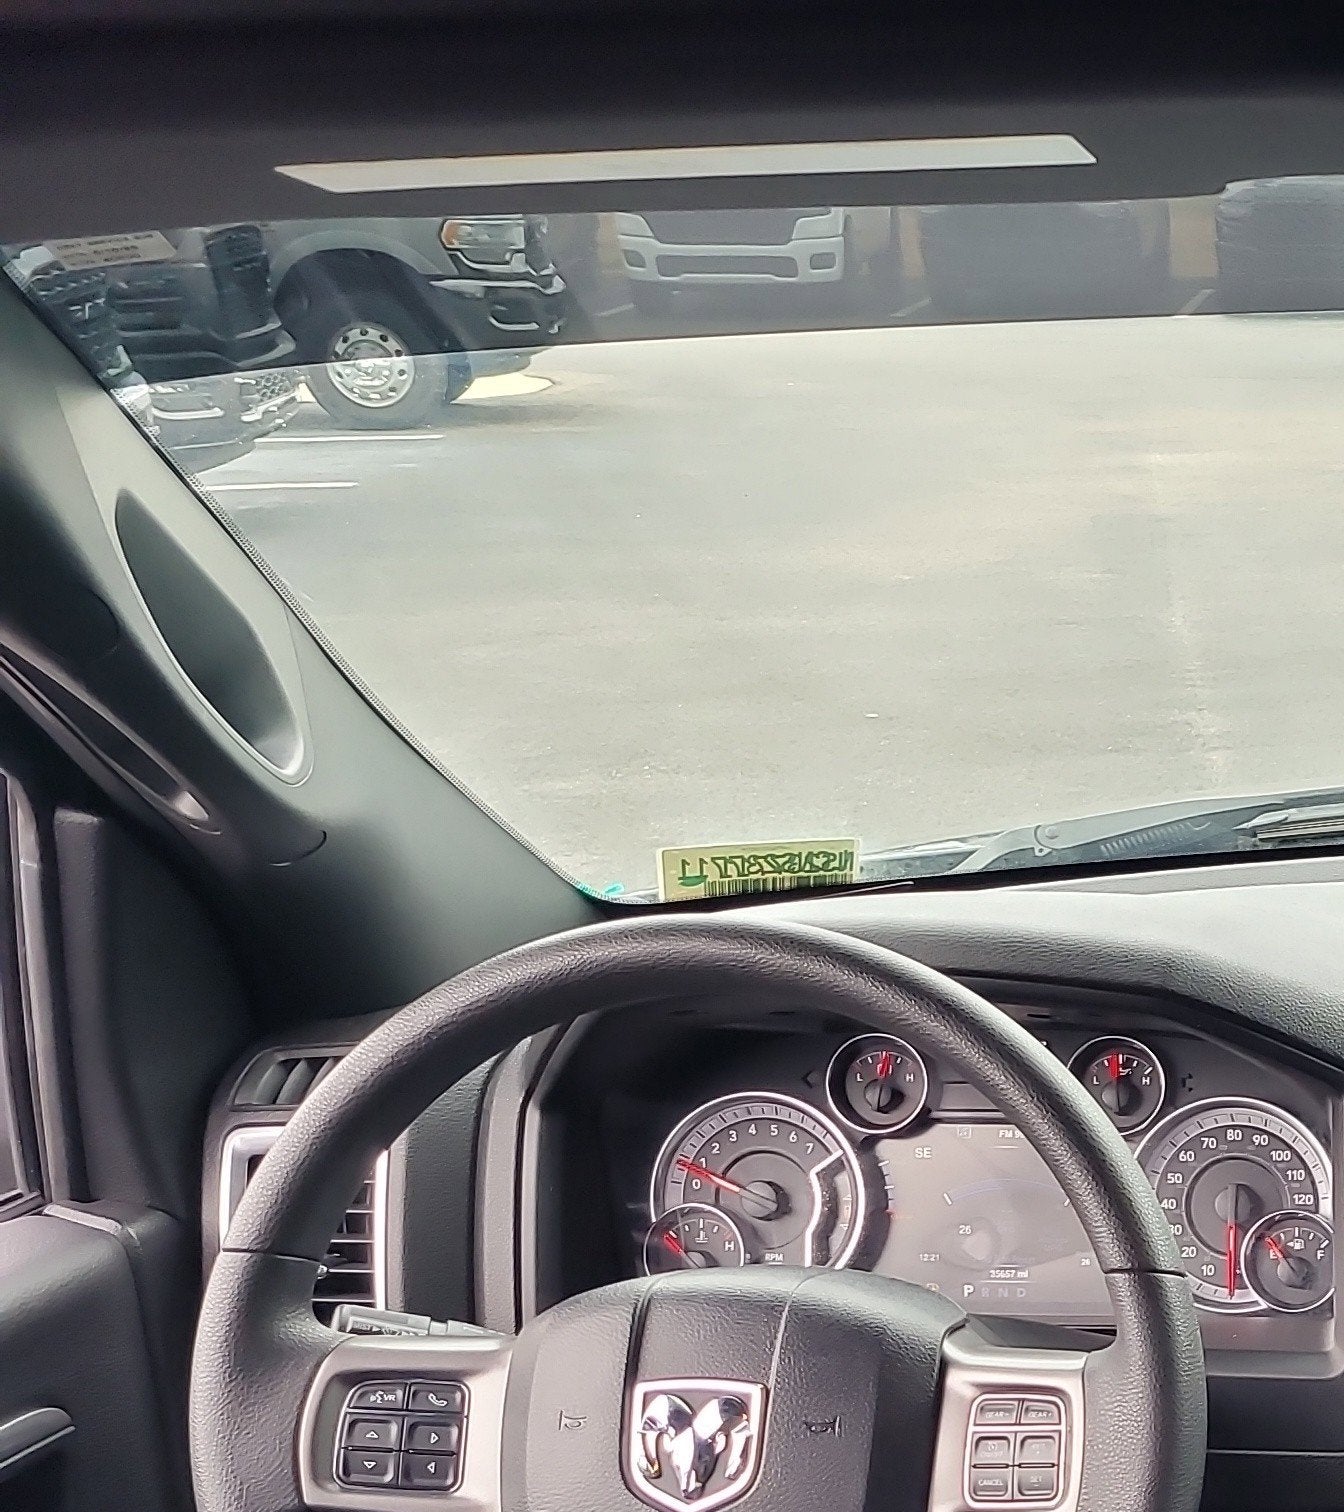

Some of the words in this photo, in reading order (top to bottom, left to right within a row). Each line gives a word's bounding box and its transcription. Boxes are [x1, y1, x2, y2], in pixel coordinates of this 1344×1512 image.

[905, 1073, 914, 1082] H
[1141, 1076, 1150, 1086] H
[748, 1124, 757, 1135] 4
[770, 1124, 779, 1136] 5
[1226, 1129, 1243, 1141] 80
[729, 1131, 738, 1142] 3
[789, 1131, 798, 1143] 6
[1252, 1134, 1269, 1146] 90
[711, 1142, 721, 1154] 2
[805, 1142, 814, 1154] 7
[1200, 1137, 1217, 1149] 70
[914, 1147, 933, 1159] SE
[1178, 1150, 1195, 1162] 60
[1269, 1150, 1291, 1162] 100
[1166, 1173, 1183, 1184] 50
[1286, 1169, 1306, 1181] 110
[692, 1180, 701, 1190] 0
[1161, 1198, 1177, 1210] 40
[1292, 1194, 1314, 1206] 120
[724, 1240, 735, 1251] H
[765, 1253, 784, 1261] RPM
[1181, 1246, 1197, 1258] 20
[1316, 1250, 1325, 1260] F
[1200, 1264, 1215, 1276] 10
[963, 1284, 974, 1298] P
